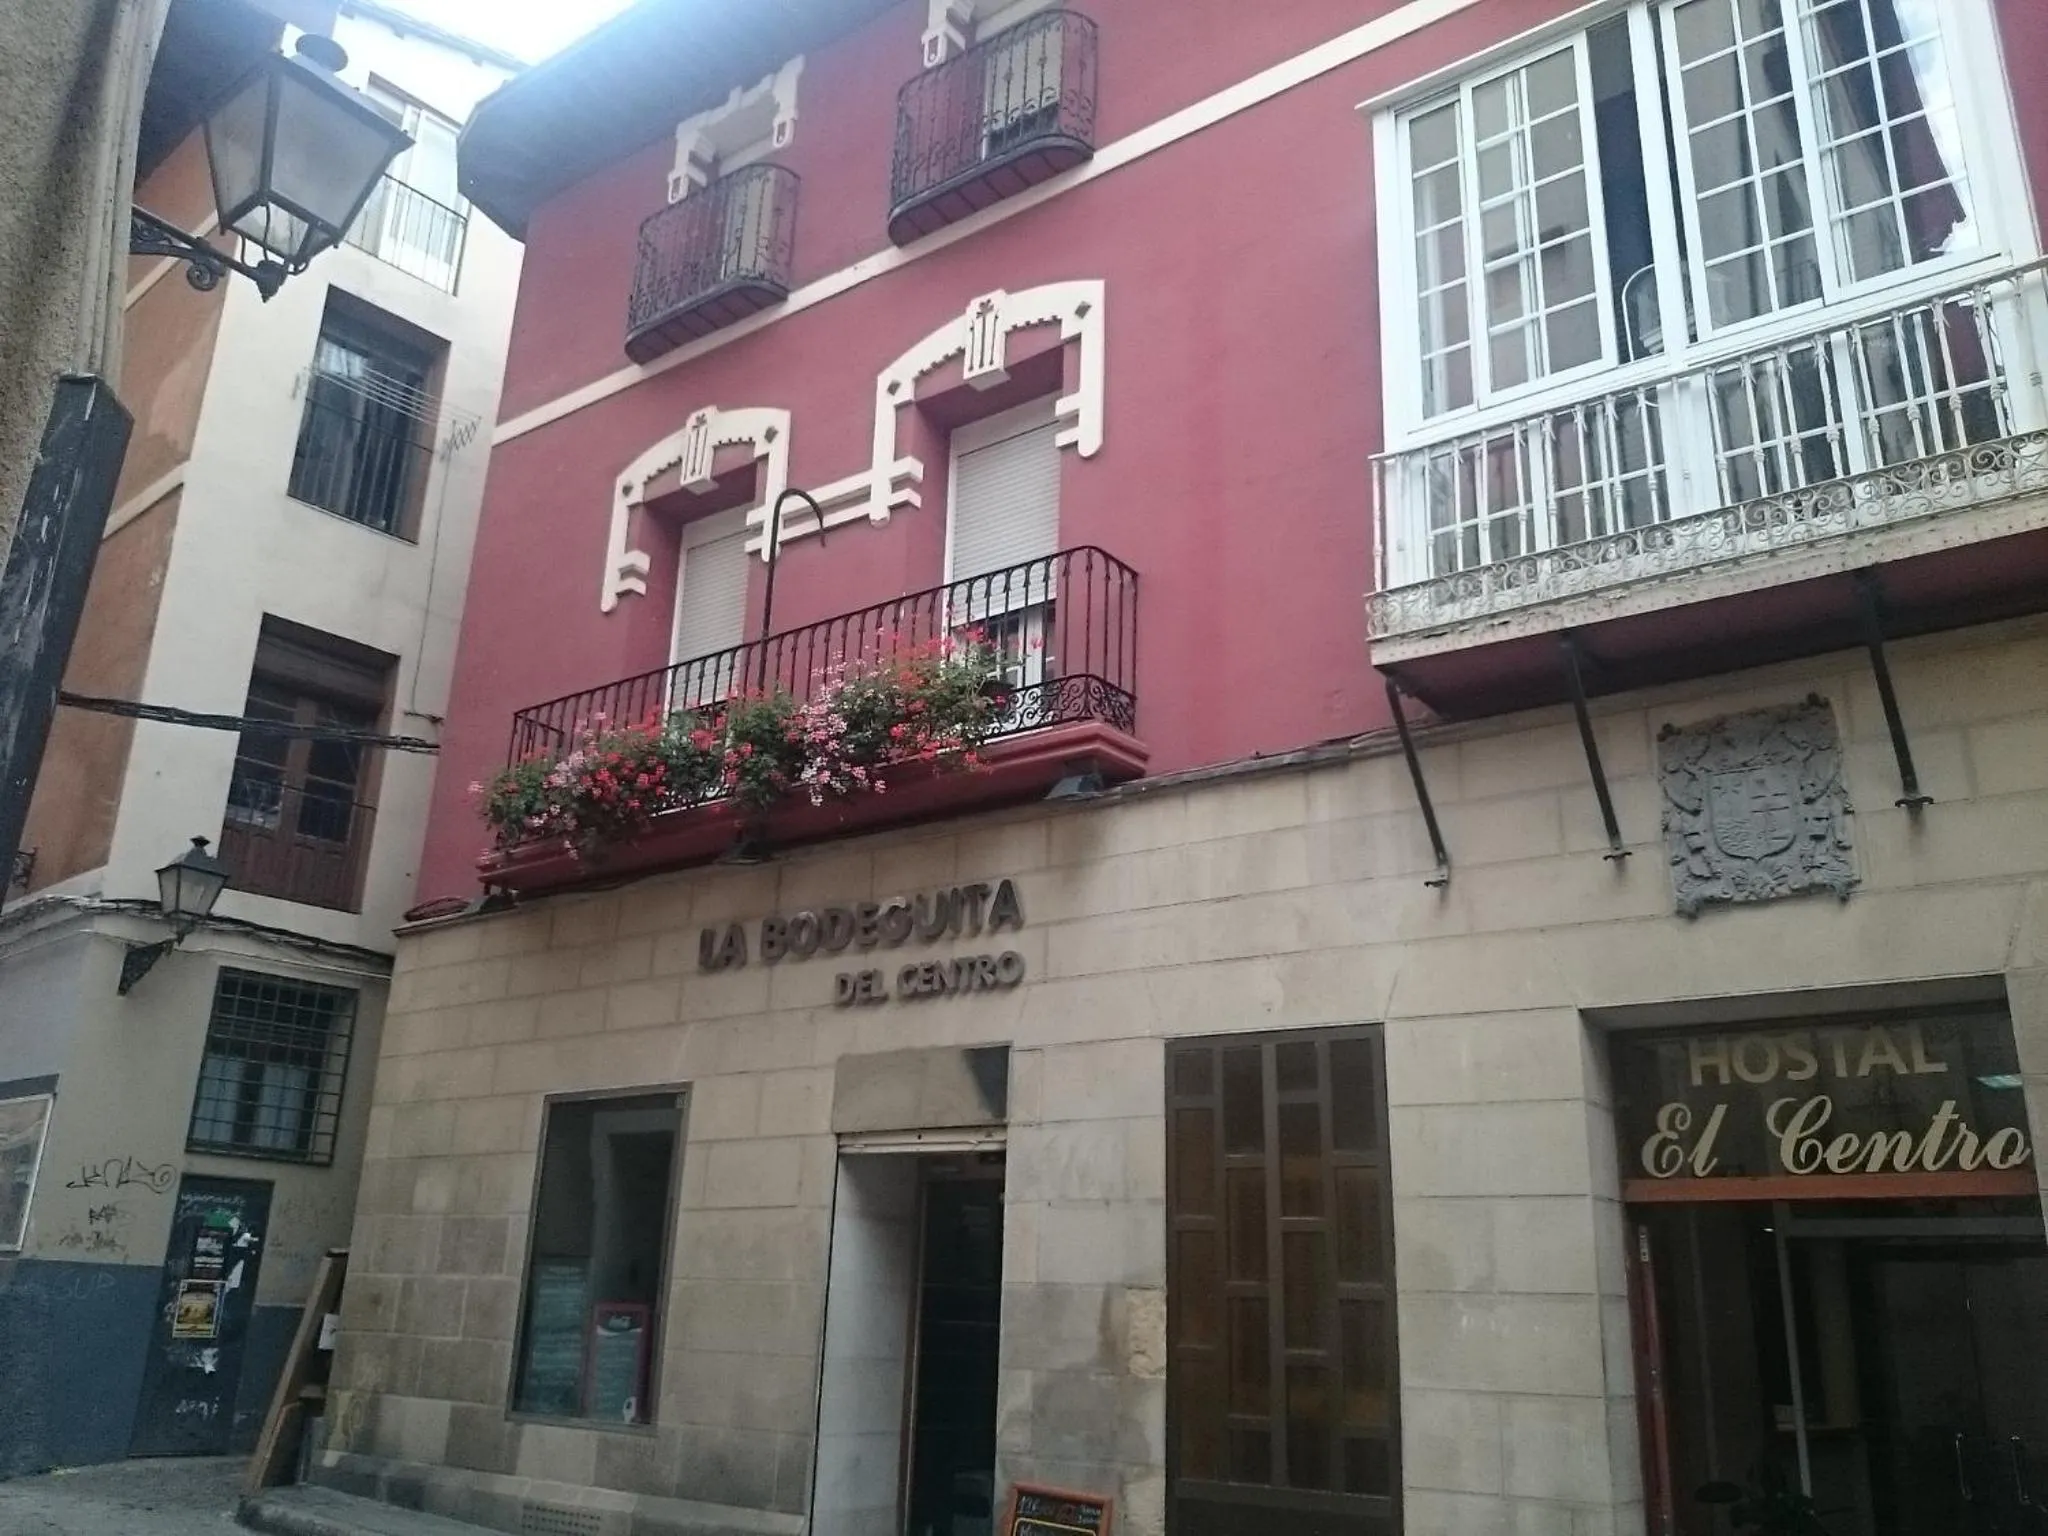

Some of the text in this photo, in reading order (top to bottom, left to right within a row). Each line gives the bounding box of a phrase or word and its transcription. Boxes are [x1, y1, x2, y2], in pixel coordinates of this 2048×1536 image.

[699, 878, 1024, 972] LA BODEGUITA
[834, 950, 1026, 1007] DEL CENTRO
[1688, 1021, 1949, 1087] HOSTAL
[1641, 1094, 2031, 1179] El Centro
